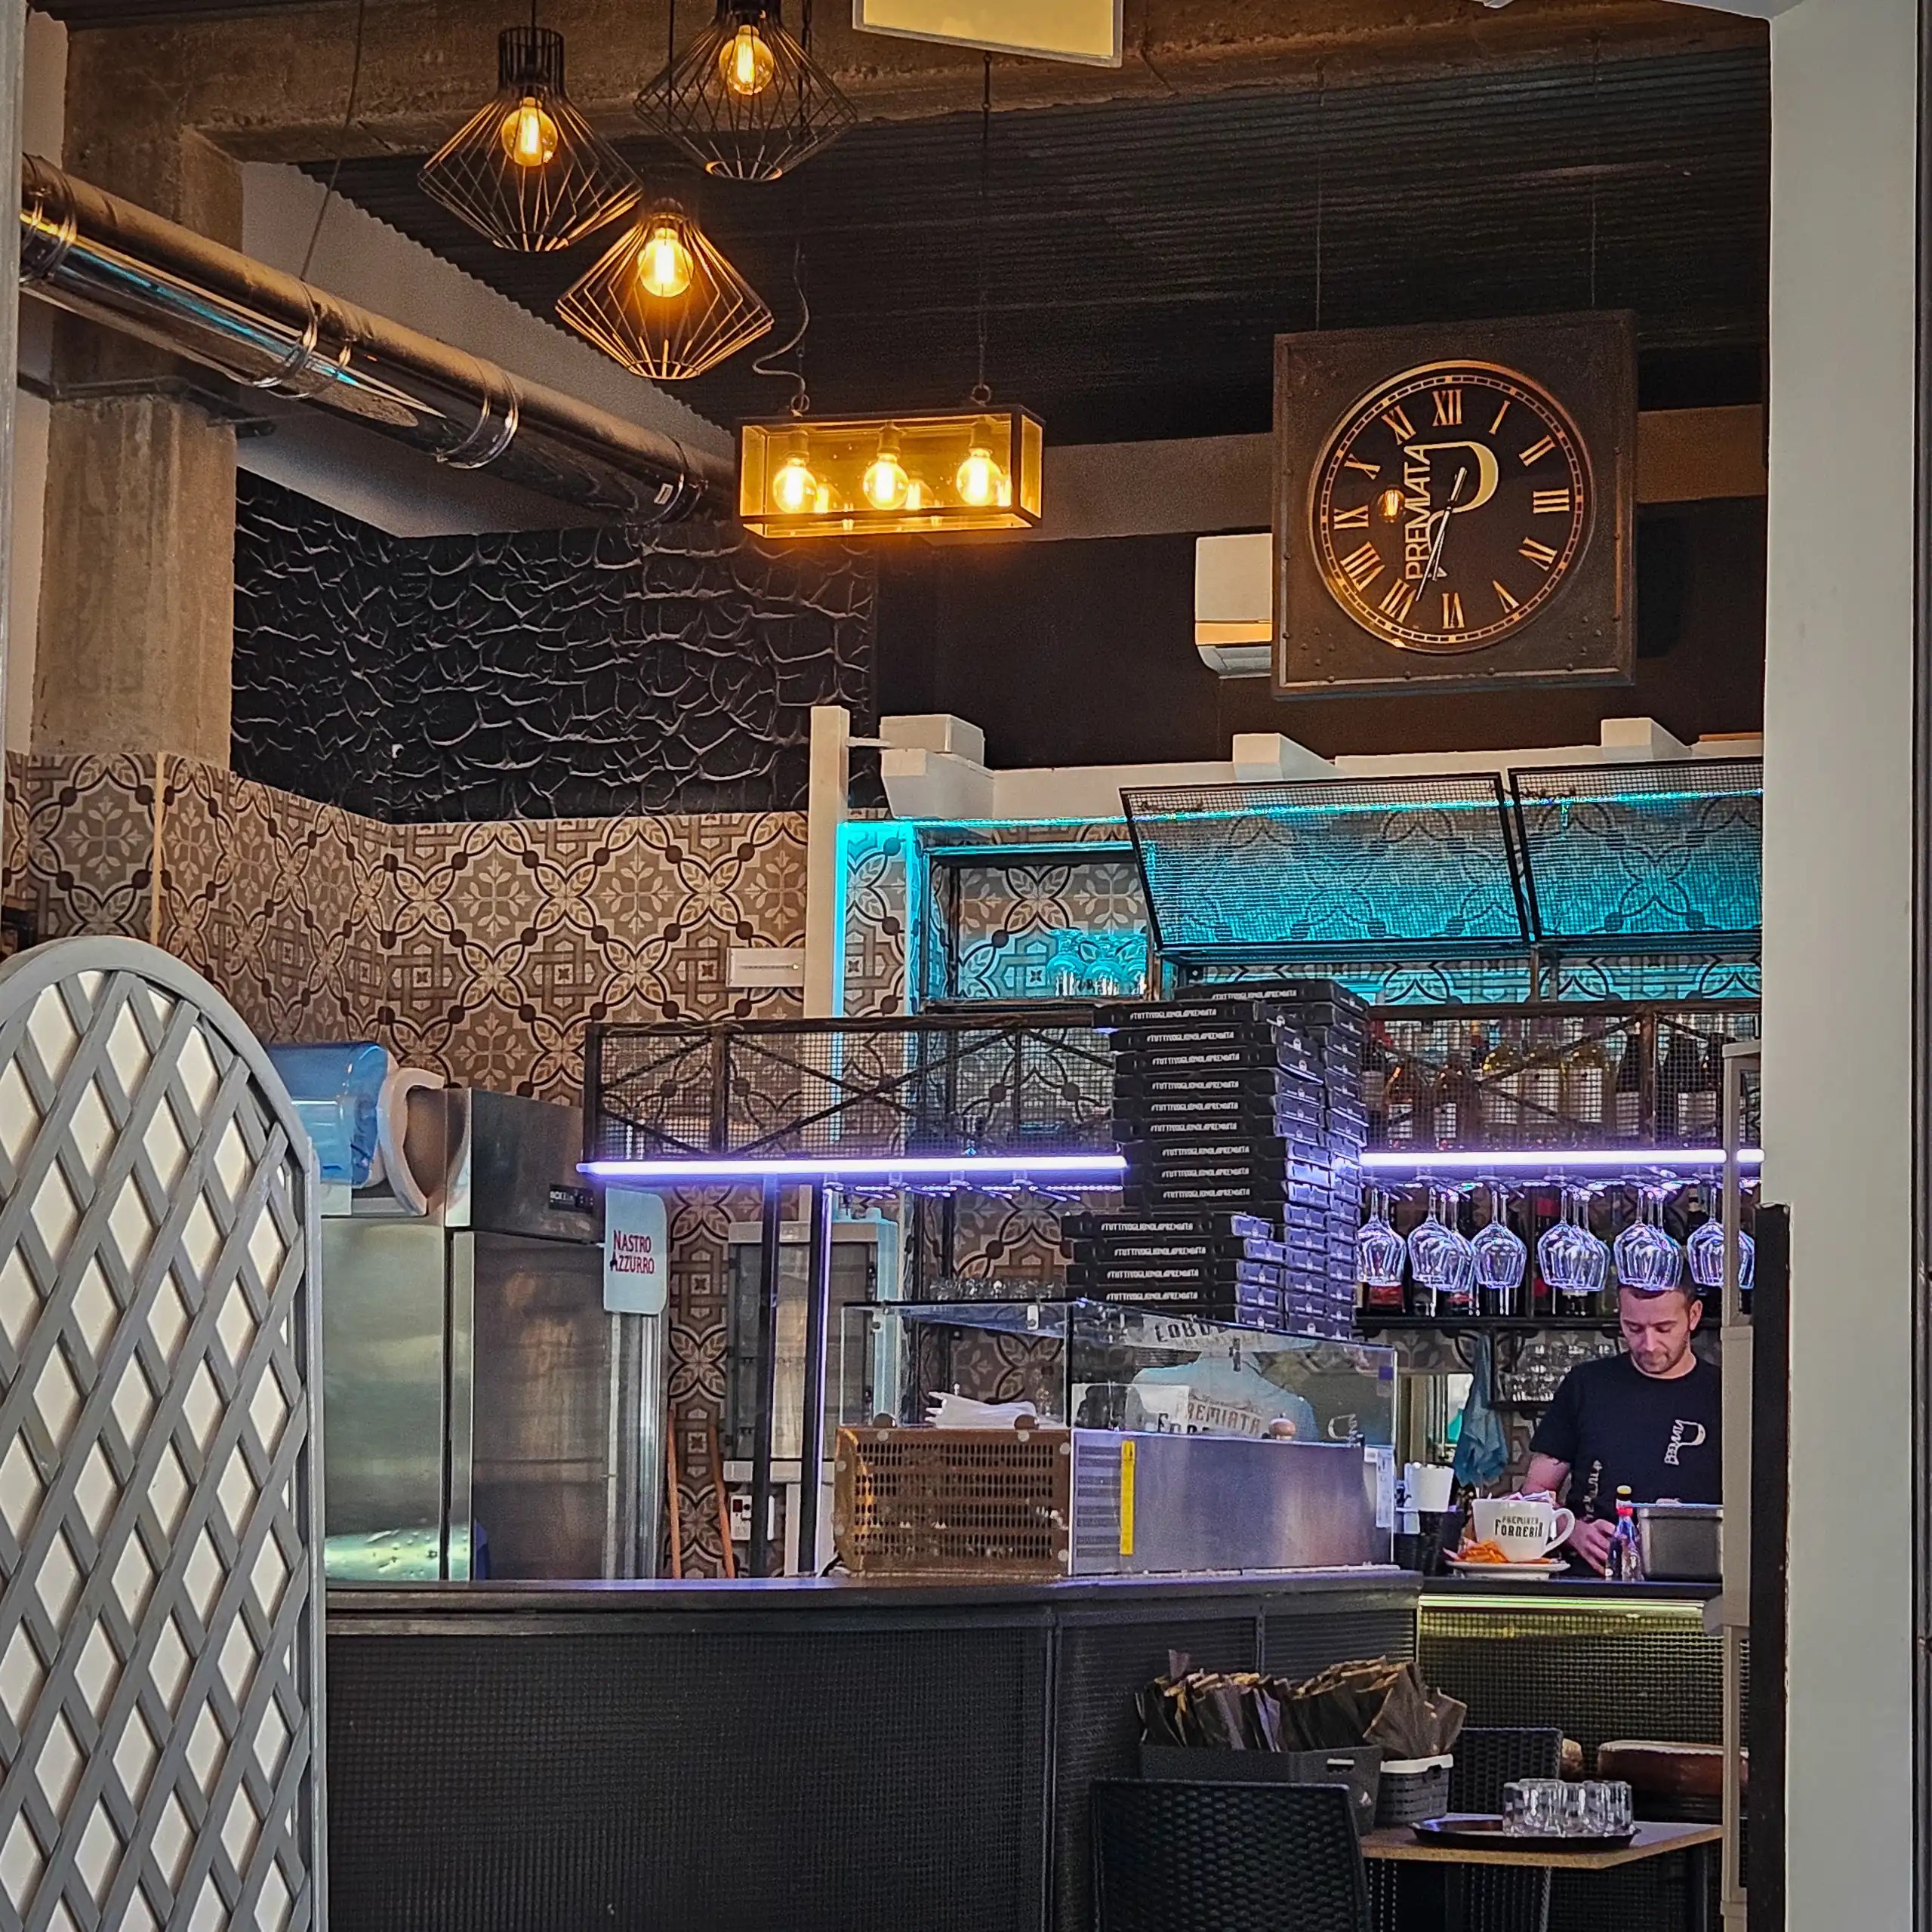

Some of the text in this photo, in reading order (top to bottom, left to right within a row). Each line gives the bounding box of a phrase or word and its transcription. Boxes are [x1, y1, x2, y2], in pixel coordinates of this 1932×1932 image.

[1432, 389, 1463, 427] XII
[1490, 399, 1511, 436] I
[1381, 405, 1417, 445] XI
[1344, 452, 1382, 481] X
[1518, 434, 1557, 467] II
[1333, 504, 1370, 531] IX
[1532, 488, 1571, 515] III
[1340, 541, 1387, 593] VIII
[1492, 579, 1521, 615] V
[613, 1229, 652, 1254] NASTRO
[609, 1252, 655, 1275] AZZURRO
